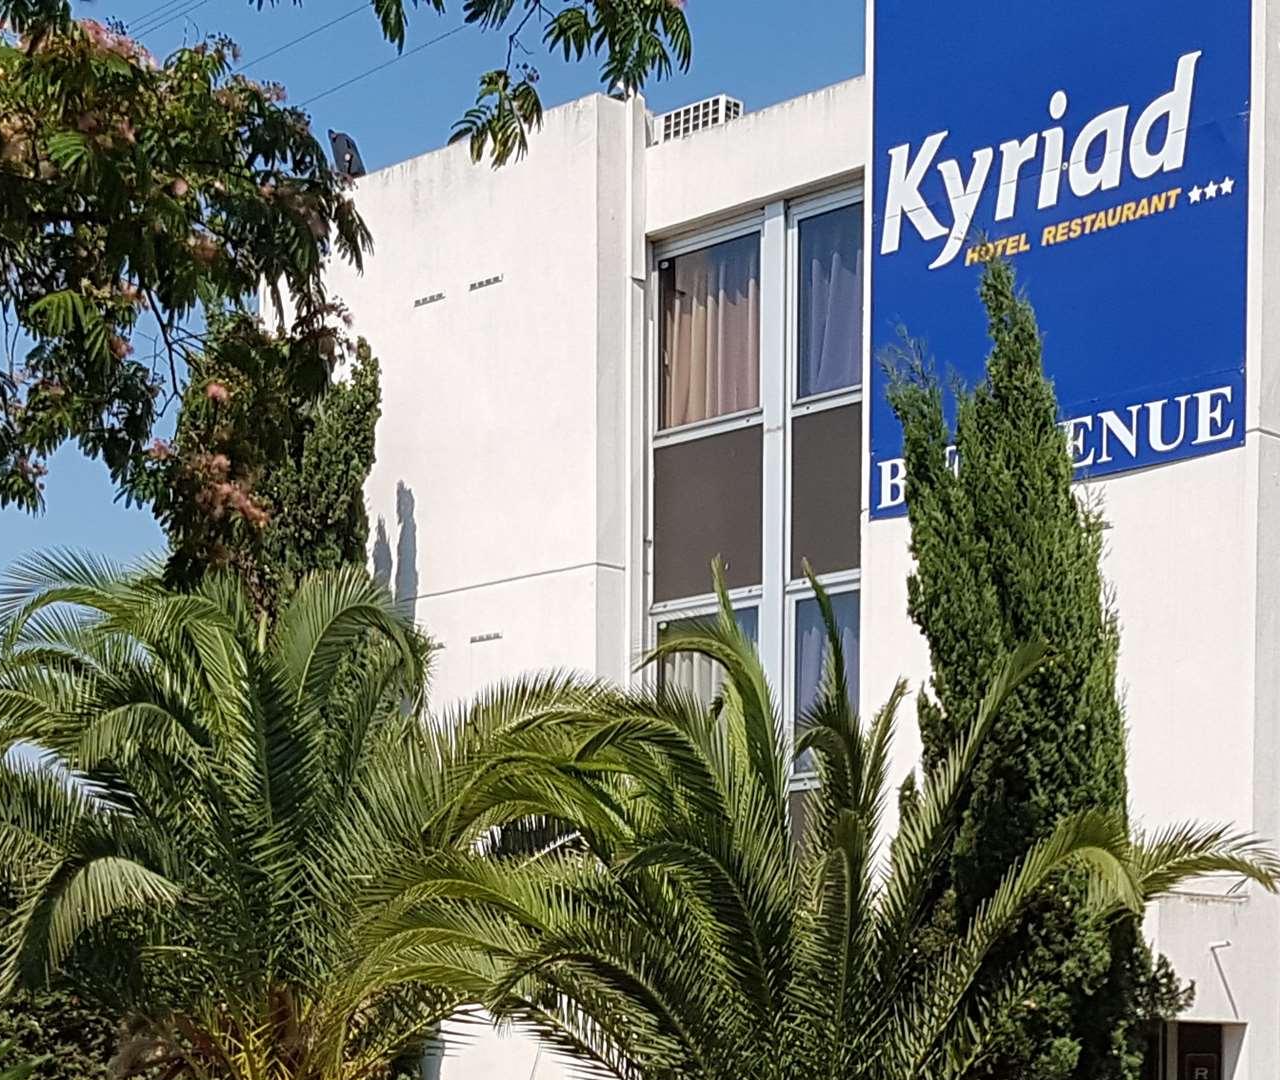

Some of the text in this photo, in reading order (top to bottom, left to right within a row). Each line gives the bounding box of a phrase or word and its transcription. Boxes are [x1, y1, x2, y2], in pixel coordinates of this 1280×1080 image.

[880, 50, 1202, 270] Kyriad
[964, 188, 1183, 267] HOTEL RESTAURANT
[876, 386, 1235, 510] BENUE
